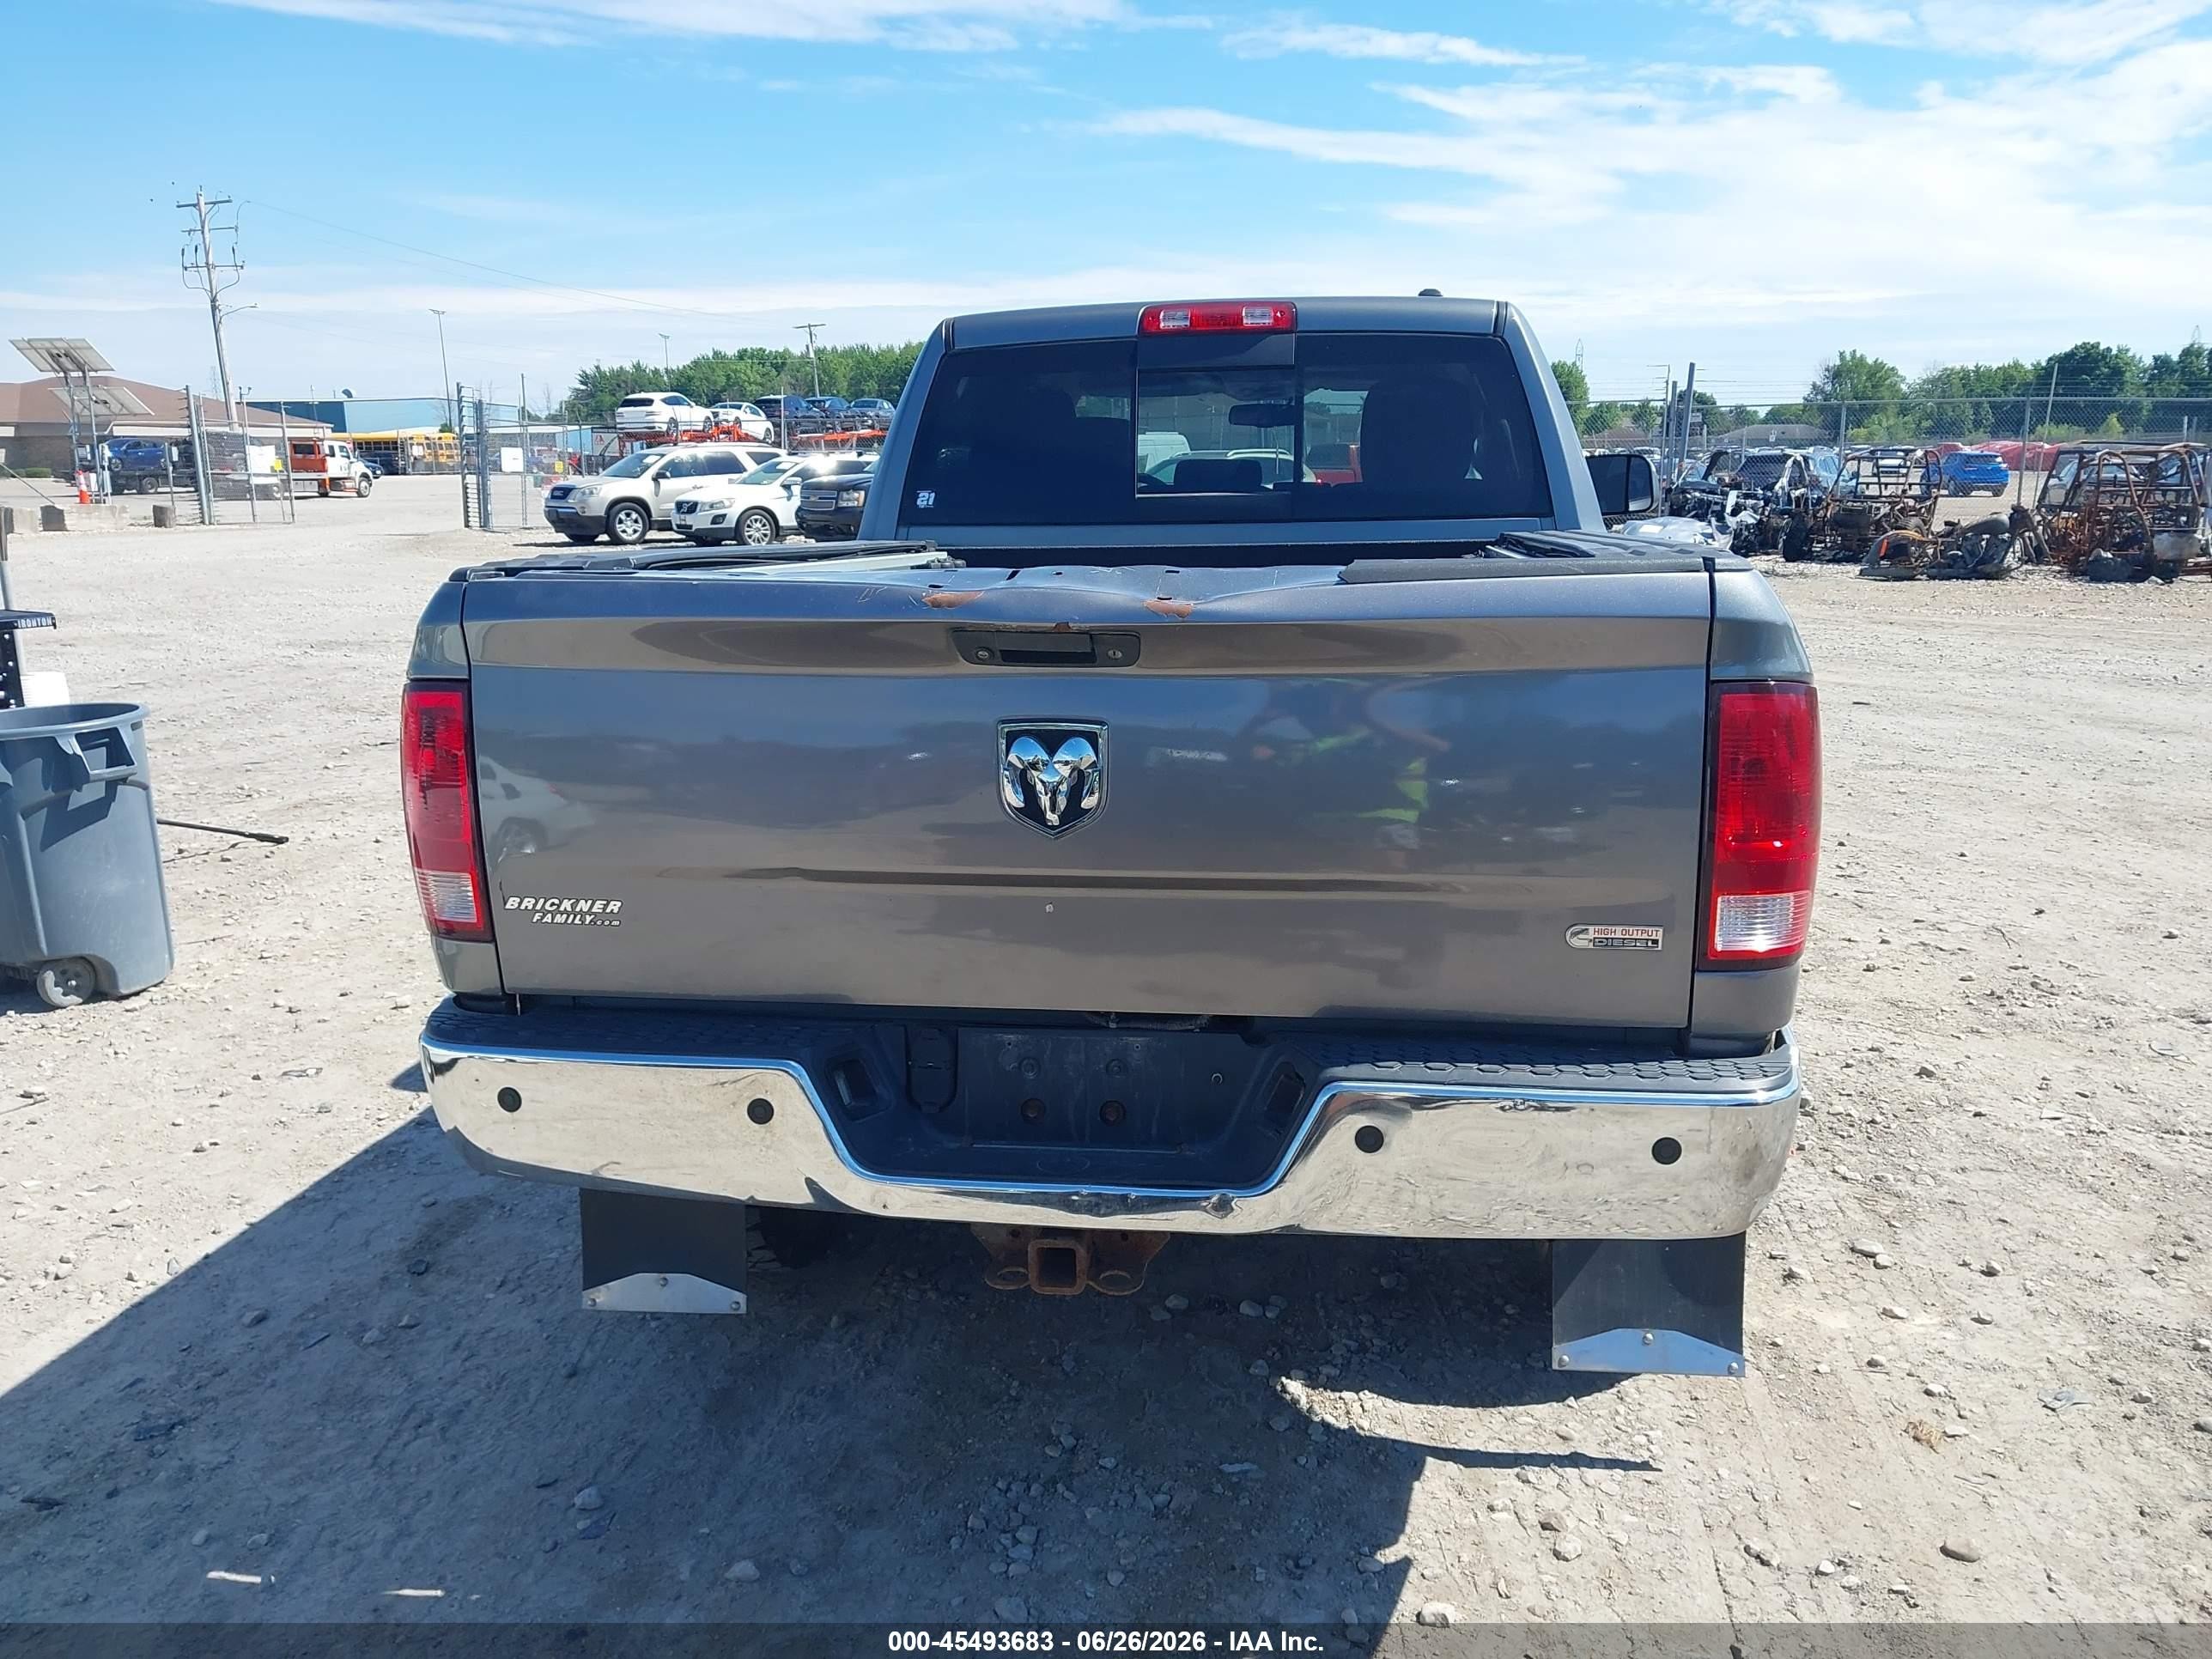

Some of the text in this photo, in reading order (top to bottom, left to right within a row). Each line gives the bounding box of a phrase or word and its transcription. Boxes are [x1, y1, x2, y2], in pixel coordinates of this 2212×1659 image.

[916, 492, 936, 506] 21
[17, 617, 52, 628] IRONTON
[504, 896, 623, 914] BRICKNER
[532, 912, 621, 927] FAMILY.com
[1593, 927, 1659, 938] HIGH OUTPUT
[1594, 939, 1658, 947] DIESEL
